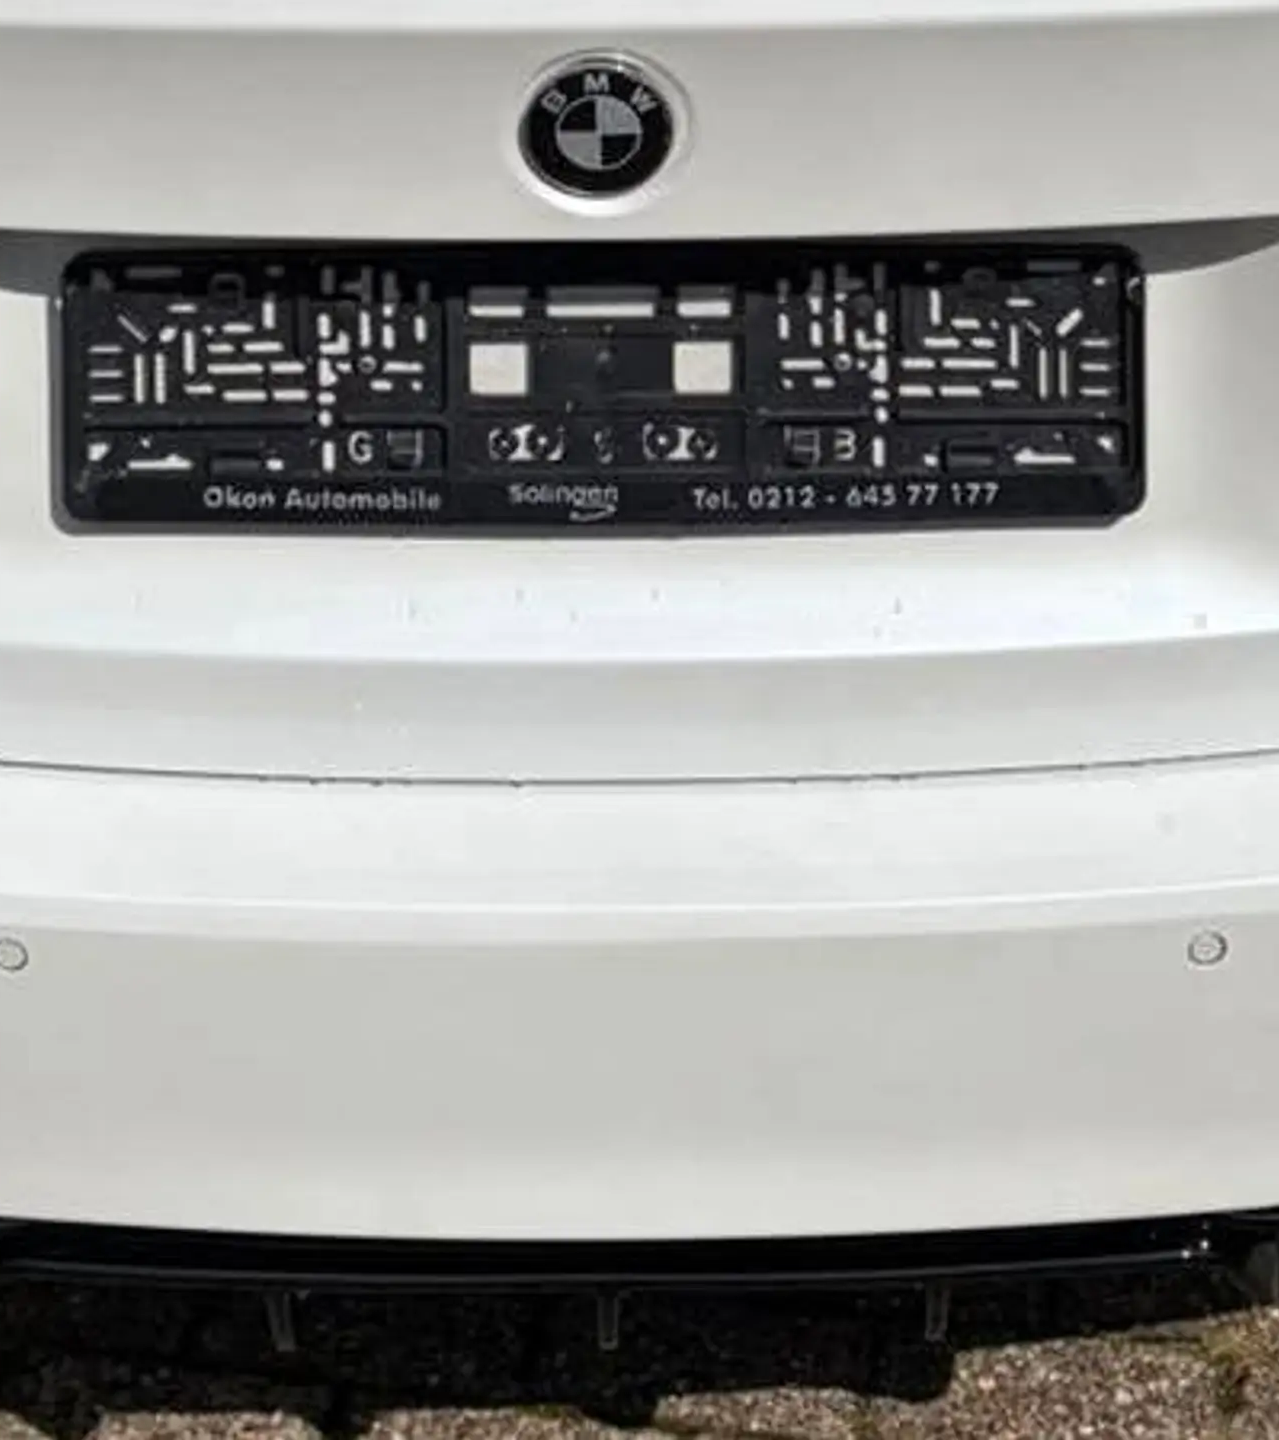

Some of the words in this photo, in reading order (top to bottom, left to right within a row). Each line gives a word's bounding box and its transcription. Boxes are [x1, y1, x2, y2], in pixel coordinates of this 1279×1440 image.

[541, 72, 658, 113] BMW
[203, 486, 275, 508] Okon
[284, 486, 442, 510] Automobile
[747, 484, 816, 509] 0212
[906, 484, 939, 506] 77
[950, 481, 999, 506] 177
